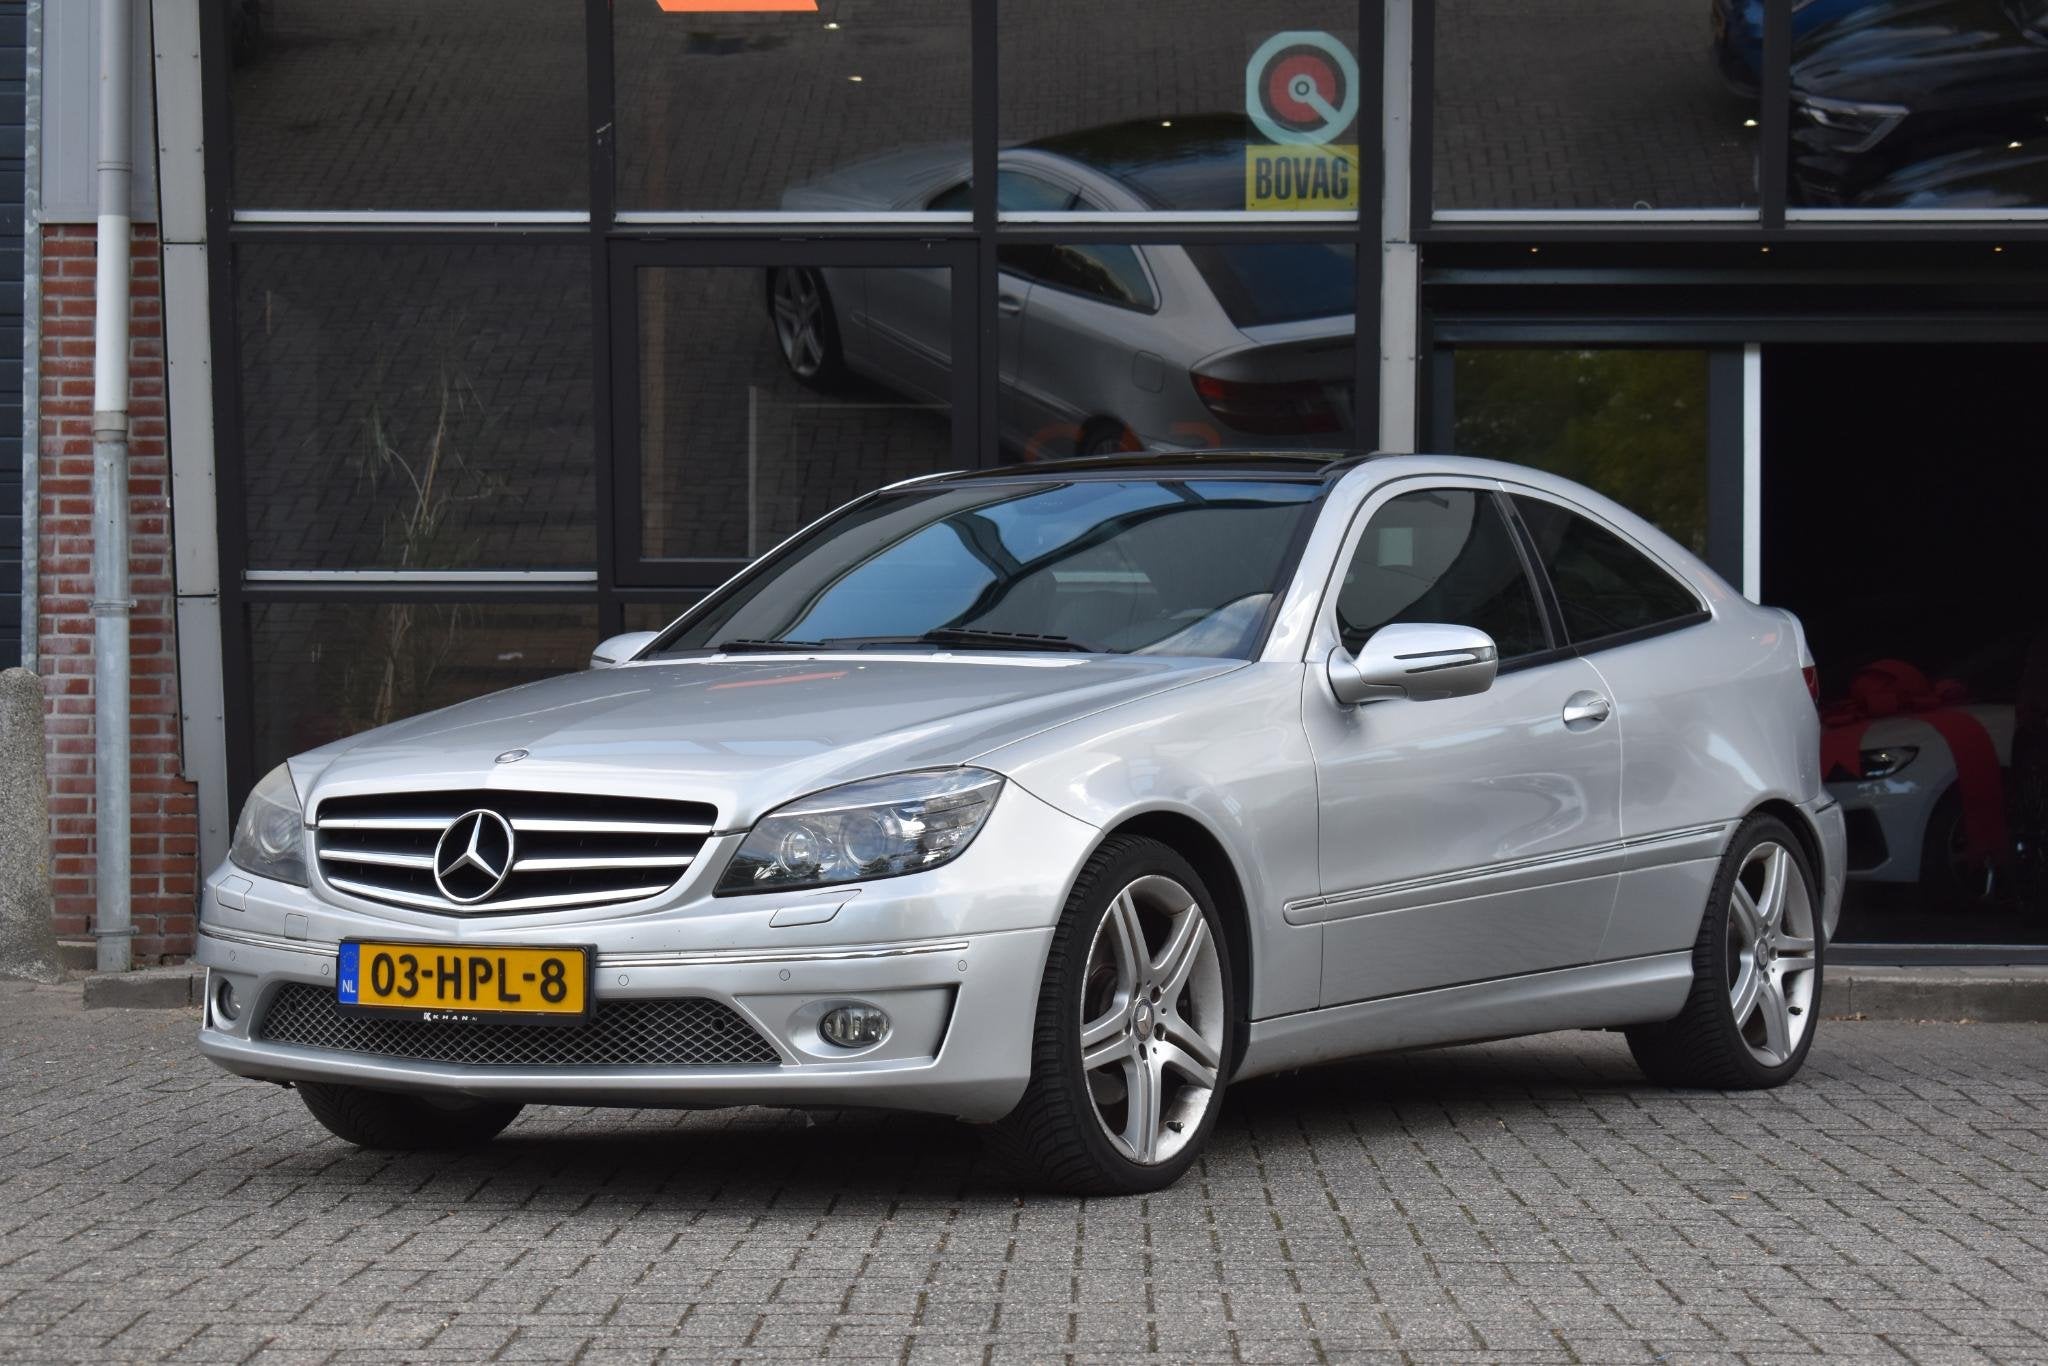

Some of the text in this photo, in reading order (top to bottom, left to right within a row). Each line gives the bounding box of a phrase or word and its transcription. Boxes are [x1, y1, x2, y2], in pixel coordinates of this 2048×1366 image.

[1256, 156, 1349, 200] BOVAG
[342, 979, 356, 993] NL
[371, 952, 567, 1003] 03-HPL-8
